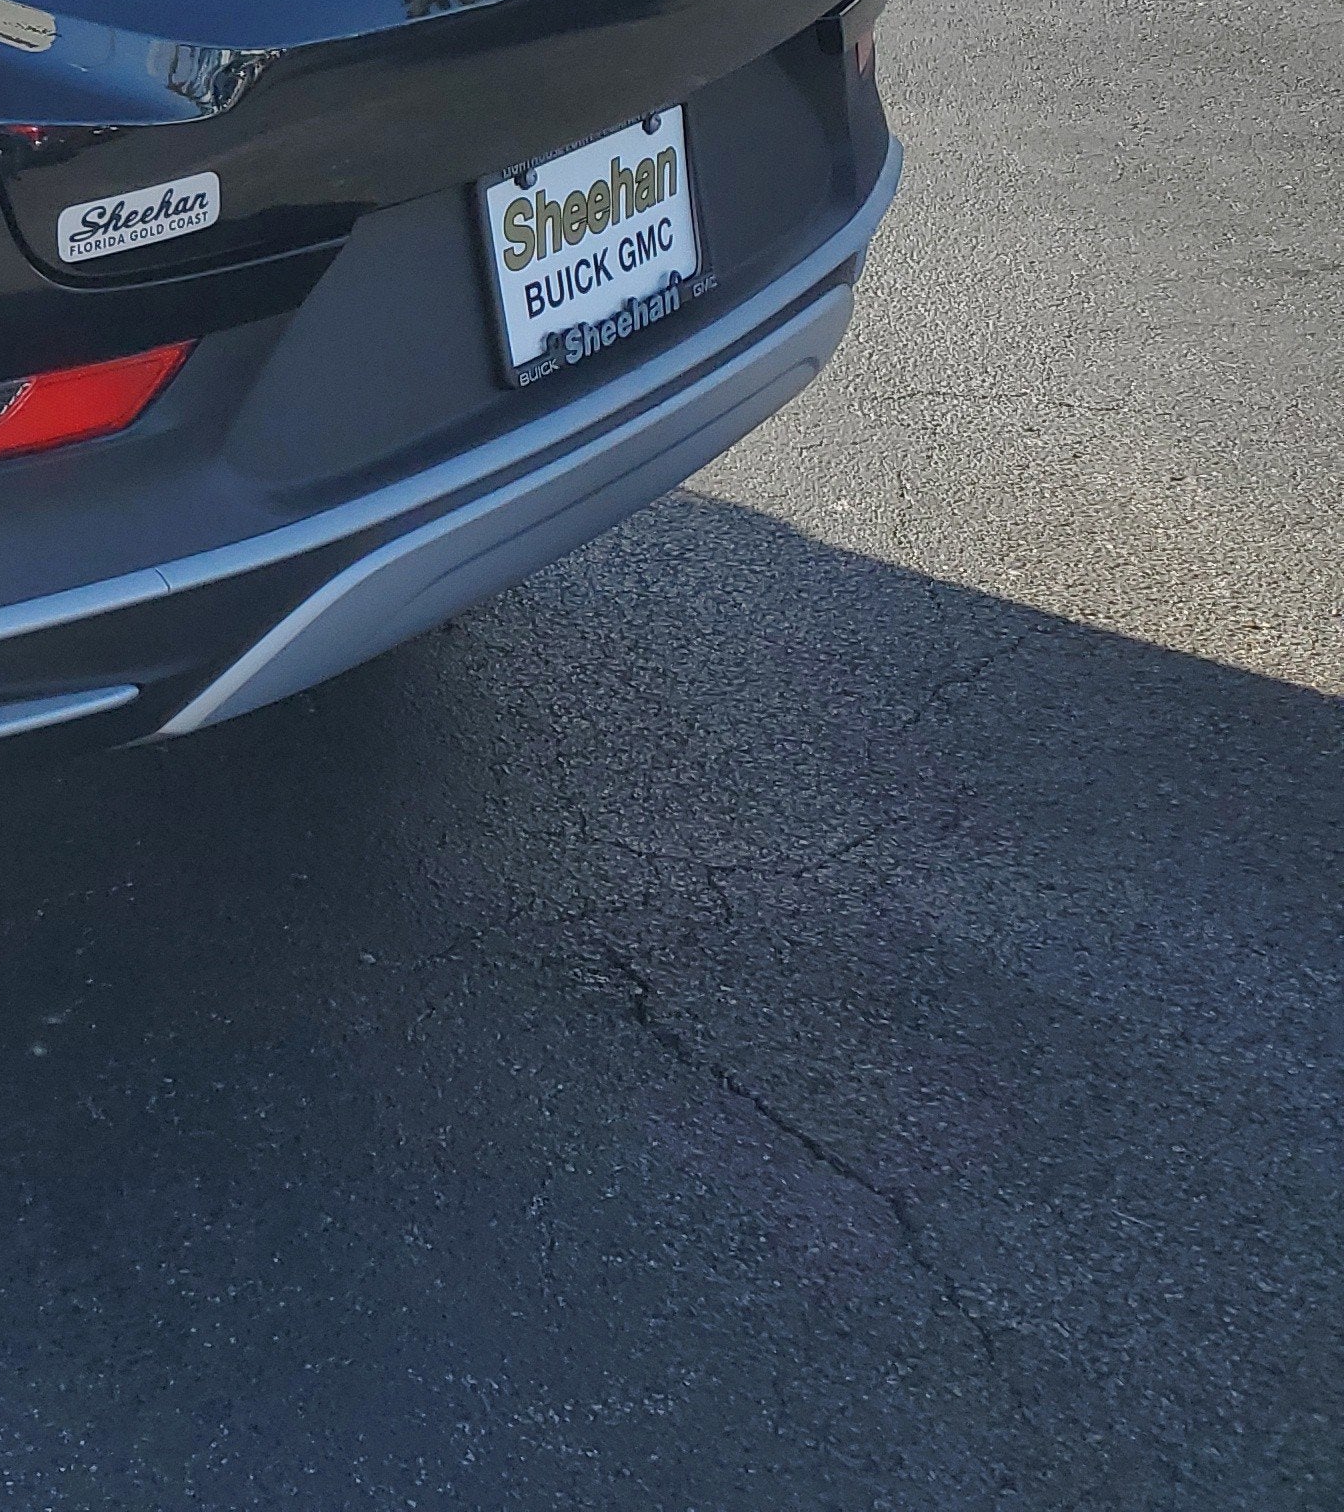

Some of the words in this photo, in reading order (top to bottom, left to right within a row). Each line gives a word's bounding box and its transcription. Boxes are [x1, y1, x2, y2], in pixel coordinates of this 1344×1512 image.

[68, 187, 210, 243] Sheehan
[69, 233, 125, 257] FLORIDA
[129, 223, 165, 242] GOLD
[168, 210, 209, 232] COAST
[502, 145, 678, 272] Sheehan
[523, 246, 615, 320] BUICK
[617, 216, 675, 273] GMC
[518, 357, 560, 387] BUICK
[564, 285, 682, 365] Sheehan
